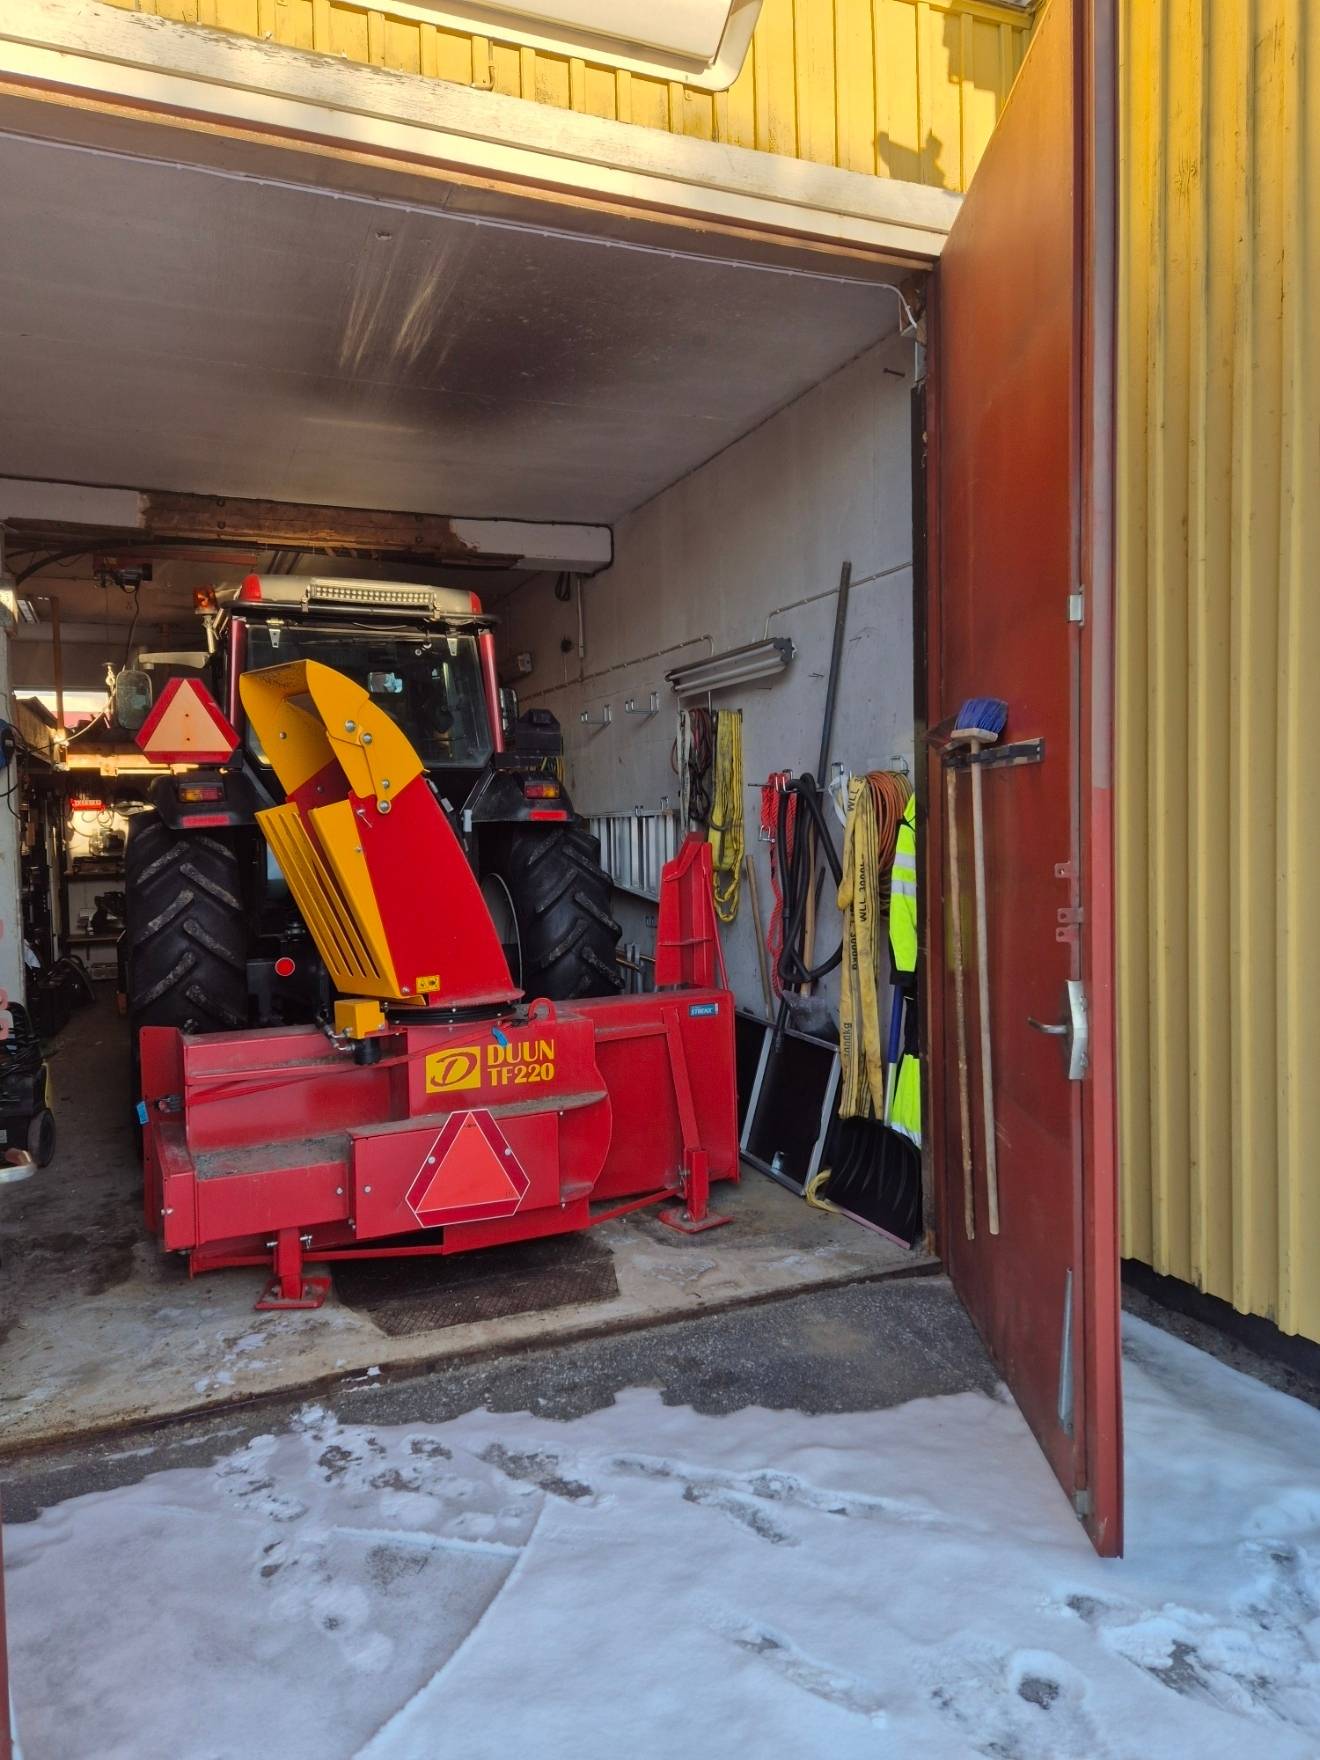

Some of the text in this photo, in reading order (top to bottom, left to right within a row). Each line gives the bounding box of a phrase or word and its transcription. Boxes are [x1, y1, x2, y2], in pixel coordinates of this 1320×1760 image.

[858, 898, 867, 922] WLL
[488, 1039, 556, 1066] DUUN
[487, 1062, 556, 1087] TF220
